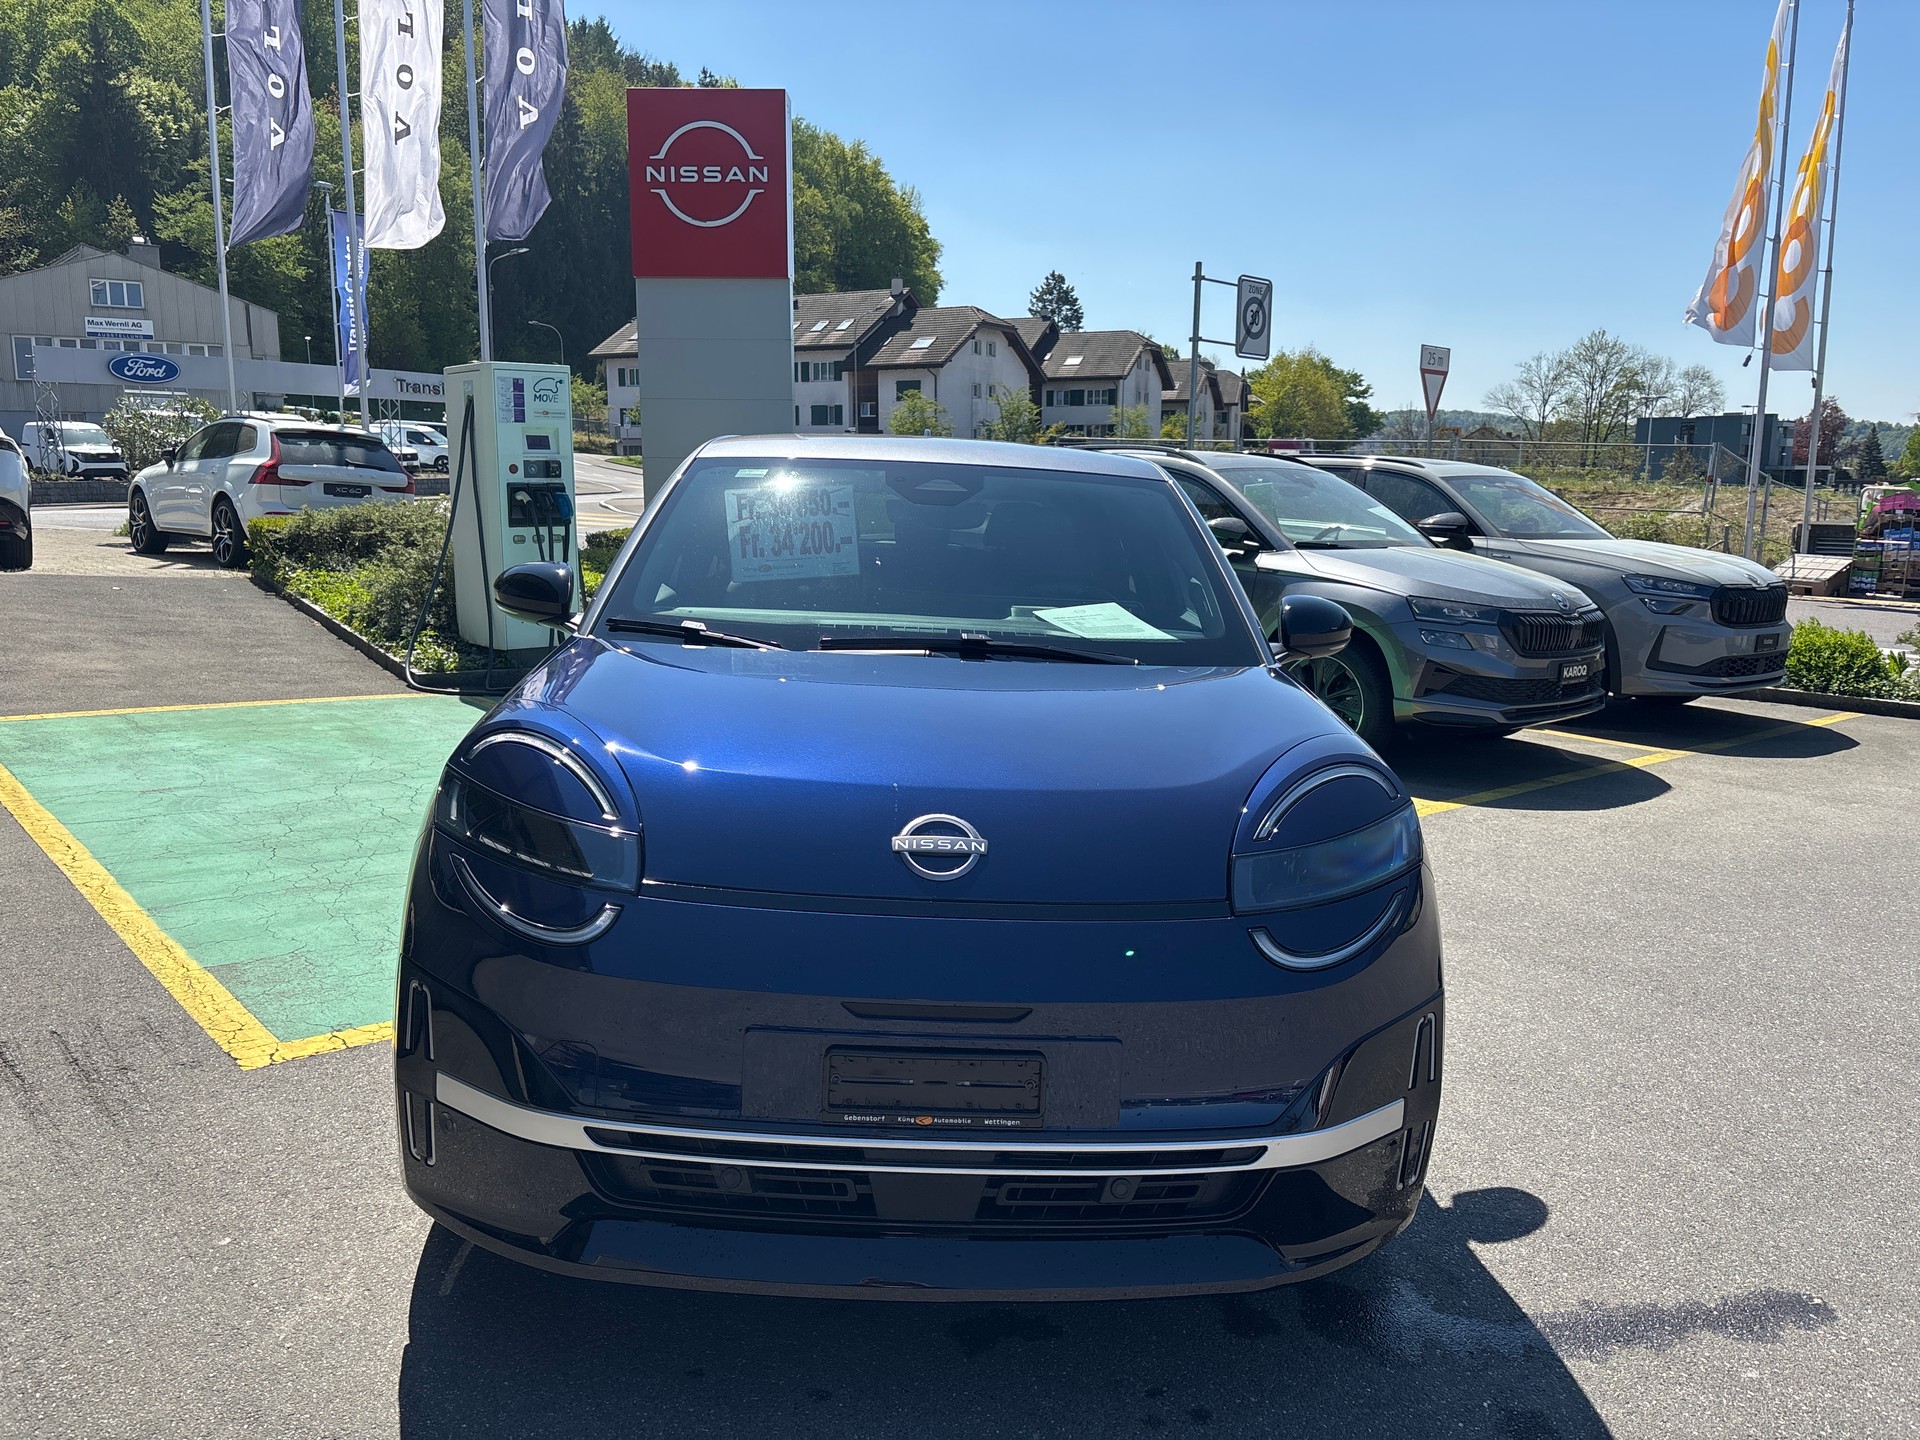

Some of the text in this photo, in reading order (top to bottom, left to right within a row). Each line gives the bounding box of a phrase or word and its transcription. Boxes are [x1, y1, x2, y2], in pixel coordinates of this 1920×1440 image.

[263, 0, 286, 151] VOL
[645, 165, 768, 183] NISSAN
[1248, 284, 1264, 296] ZONE
[87, 319, 104, 327] Max
[104, 320, 129, 328] Wernli
[1249, 309, 1260, 327] 30
[1427, 351, 1444, 367] 25 m
[123, 358, 167, 378] Ford
[533, 393, 559, 403] MOVE
[739, 526, 765, 558] Fr.
[1563, 664, 1588, 679] KAROQ
[895, 839, 985, 852] NISSAN
[897, 1116, 915, 1124] Küng
[984, 1118, 1021, 1127] Wettingen
